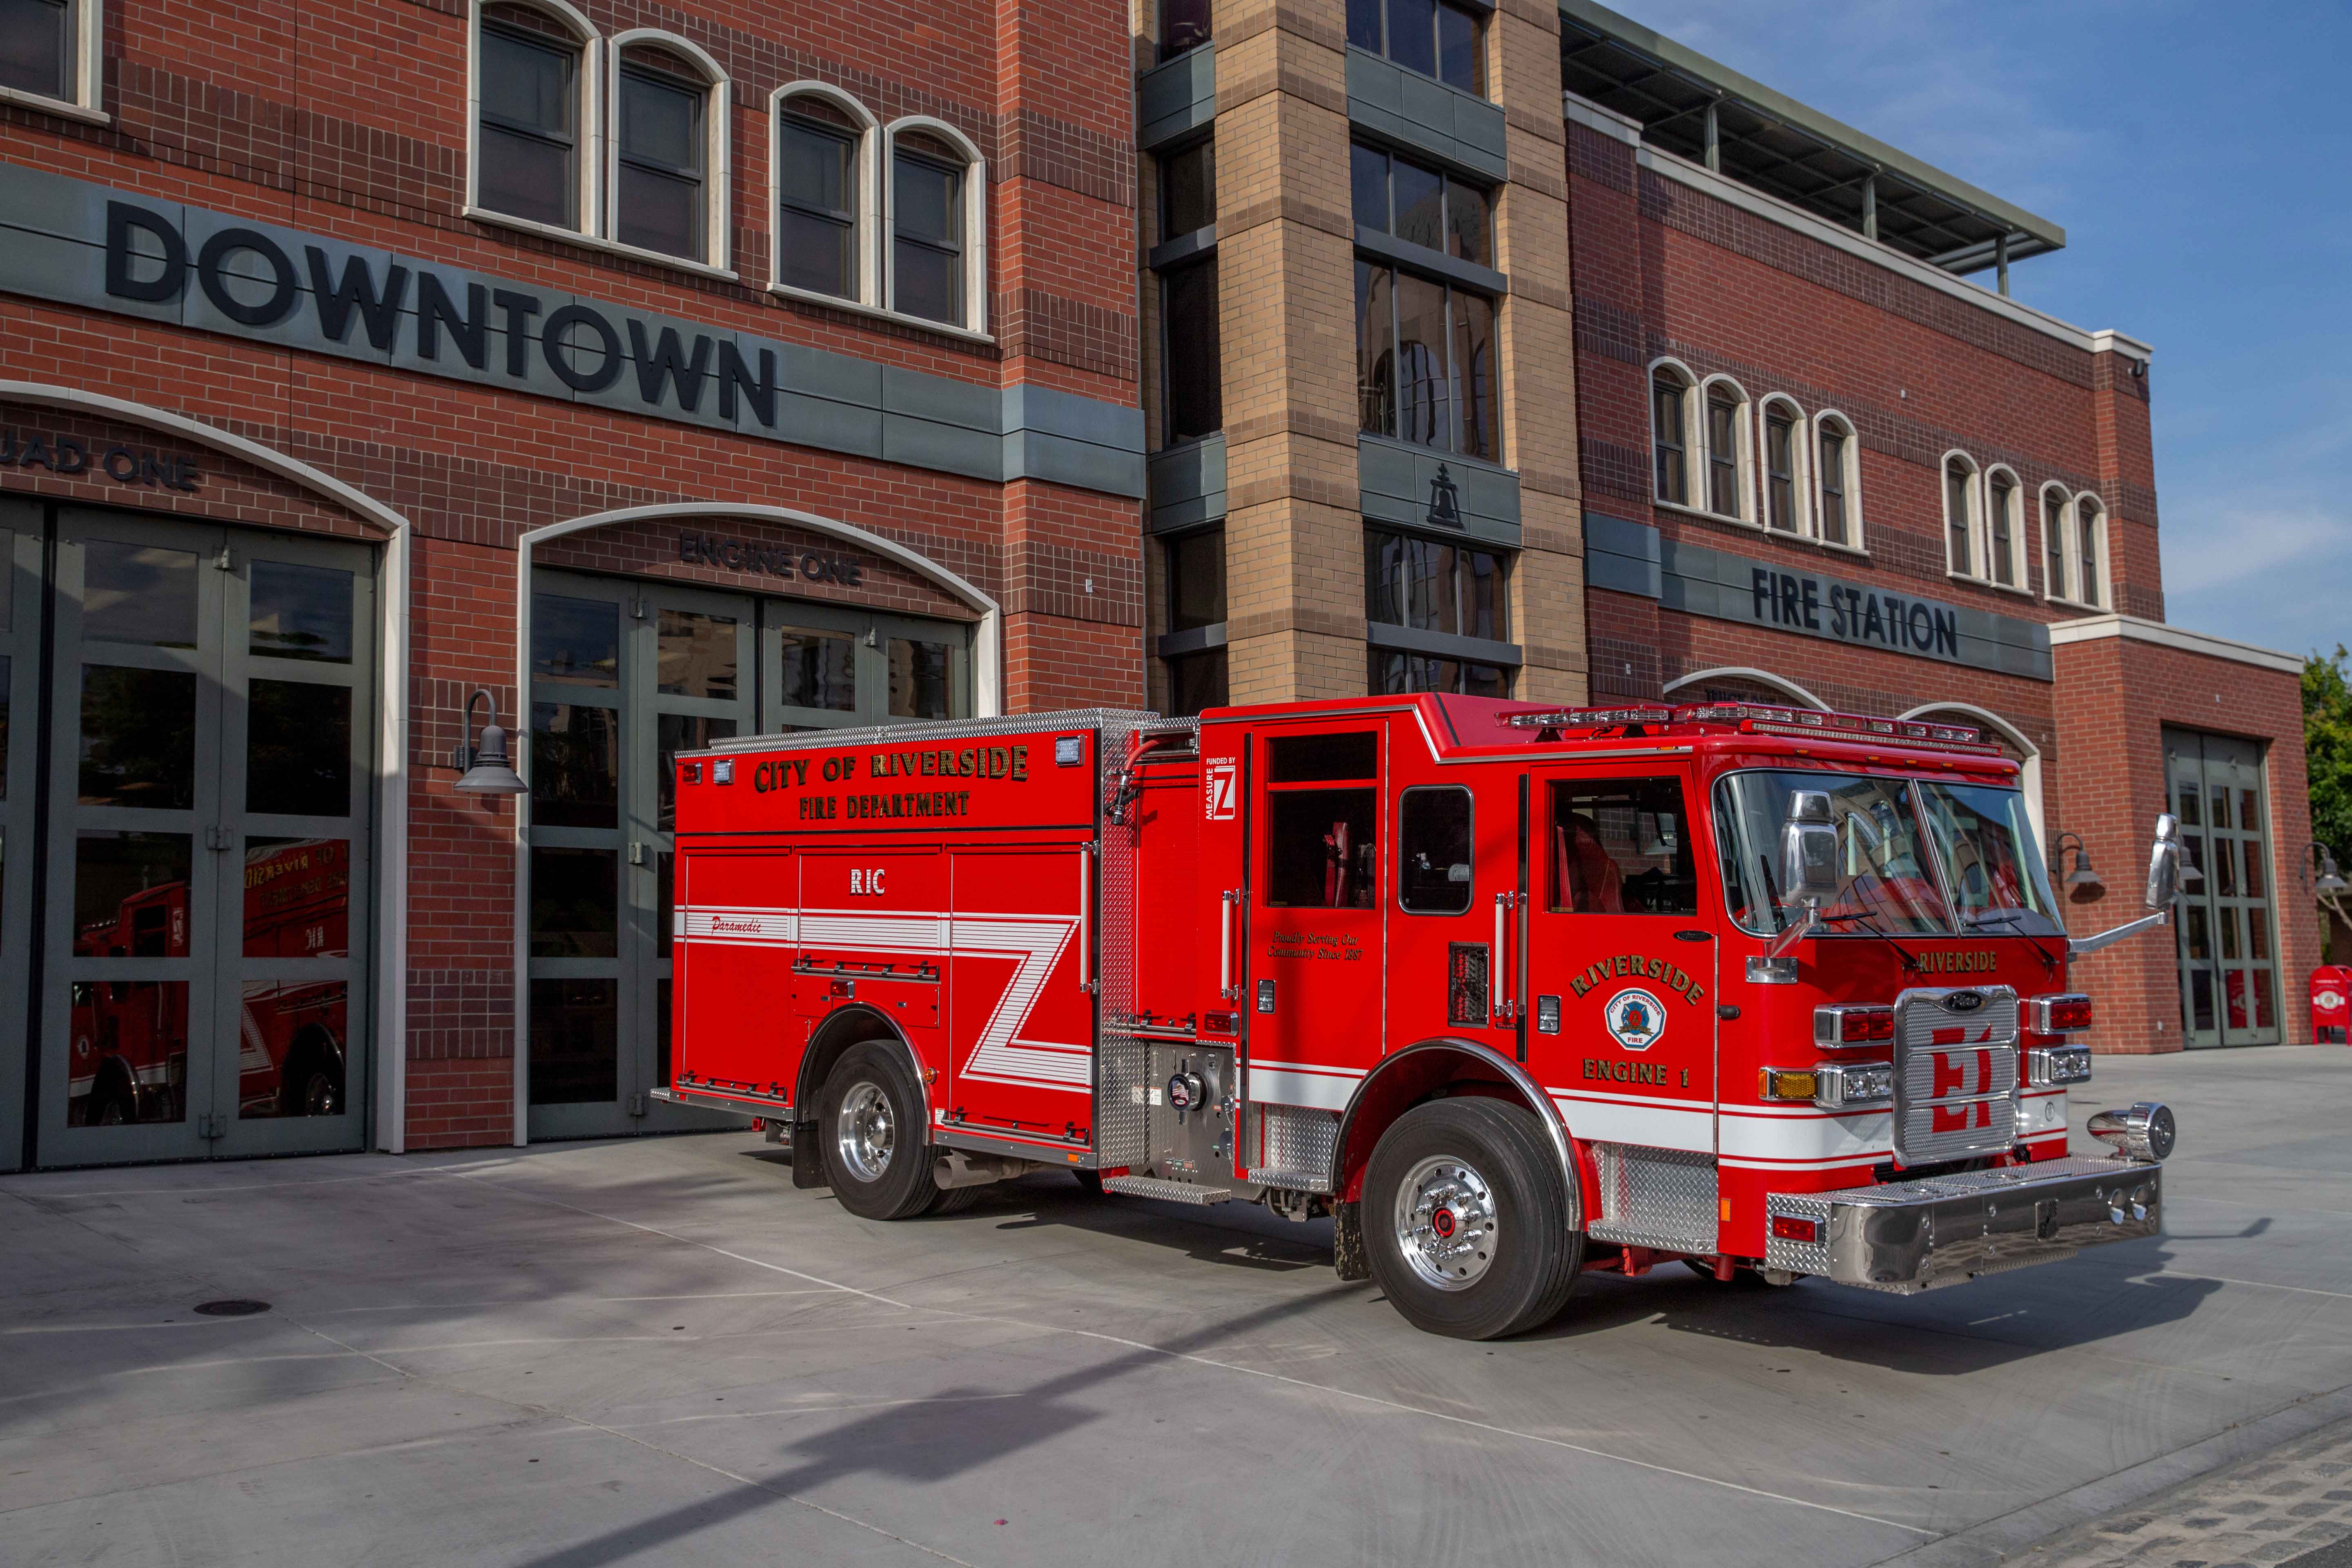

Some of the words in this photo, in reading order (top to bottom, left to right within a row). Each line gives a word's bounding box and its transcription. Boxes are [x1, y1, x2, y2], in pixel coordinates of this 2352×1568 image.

[105, 199, 776, 426] DOWNTOWN
[104, 446, 197, 491] ONE
[679, 529, 792, 577] ENGINE
[800, 552, 862, 586] ONE
[1751, 567, 1820, 630] FIRE
[1829, 584, 1958, 657] STATION
[754, 759, 811, 793] CITY
[823, 756, 856, 782] OF
[870, 745, 1029, 782] RIVERSIDE
[799, 796, 837, 820] FIRE
[846, 791, 970, 819] DEPARTMENT
[1205, 768, 1214, 820] MEASURE
[849, 869, 885, 897] RIC
[711, 915, 761, 935] Paramedic
[1273, 931, 1305, 946] Proudly
[1307, 932, 1339, 947] Serving
[1341, 934, 1359, 945] Our
[1267, 945, 1315, 960] Community
[1317, 947, 1342, 960] Since
[1344, 949, 1363, 960] 1887
[1919, 951, 1996, 973] RIVERSIDE
[1570, 954, 1705, 1006] RIVERSIDE
[1610, 999, 1621, 1013] CITY
[1632, 994, 1662, 1016] RIVERSIDE
[1583, 1058, 1668, 1086] ENGINE
[1680, 1067, 1689, 1088] 1
